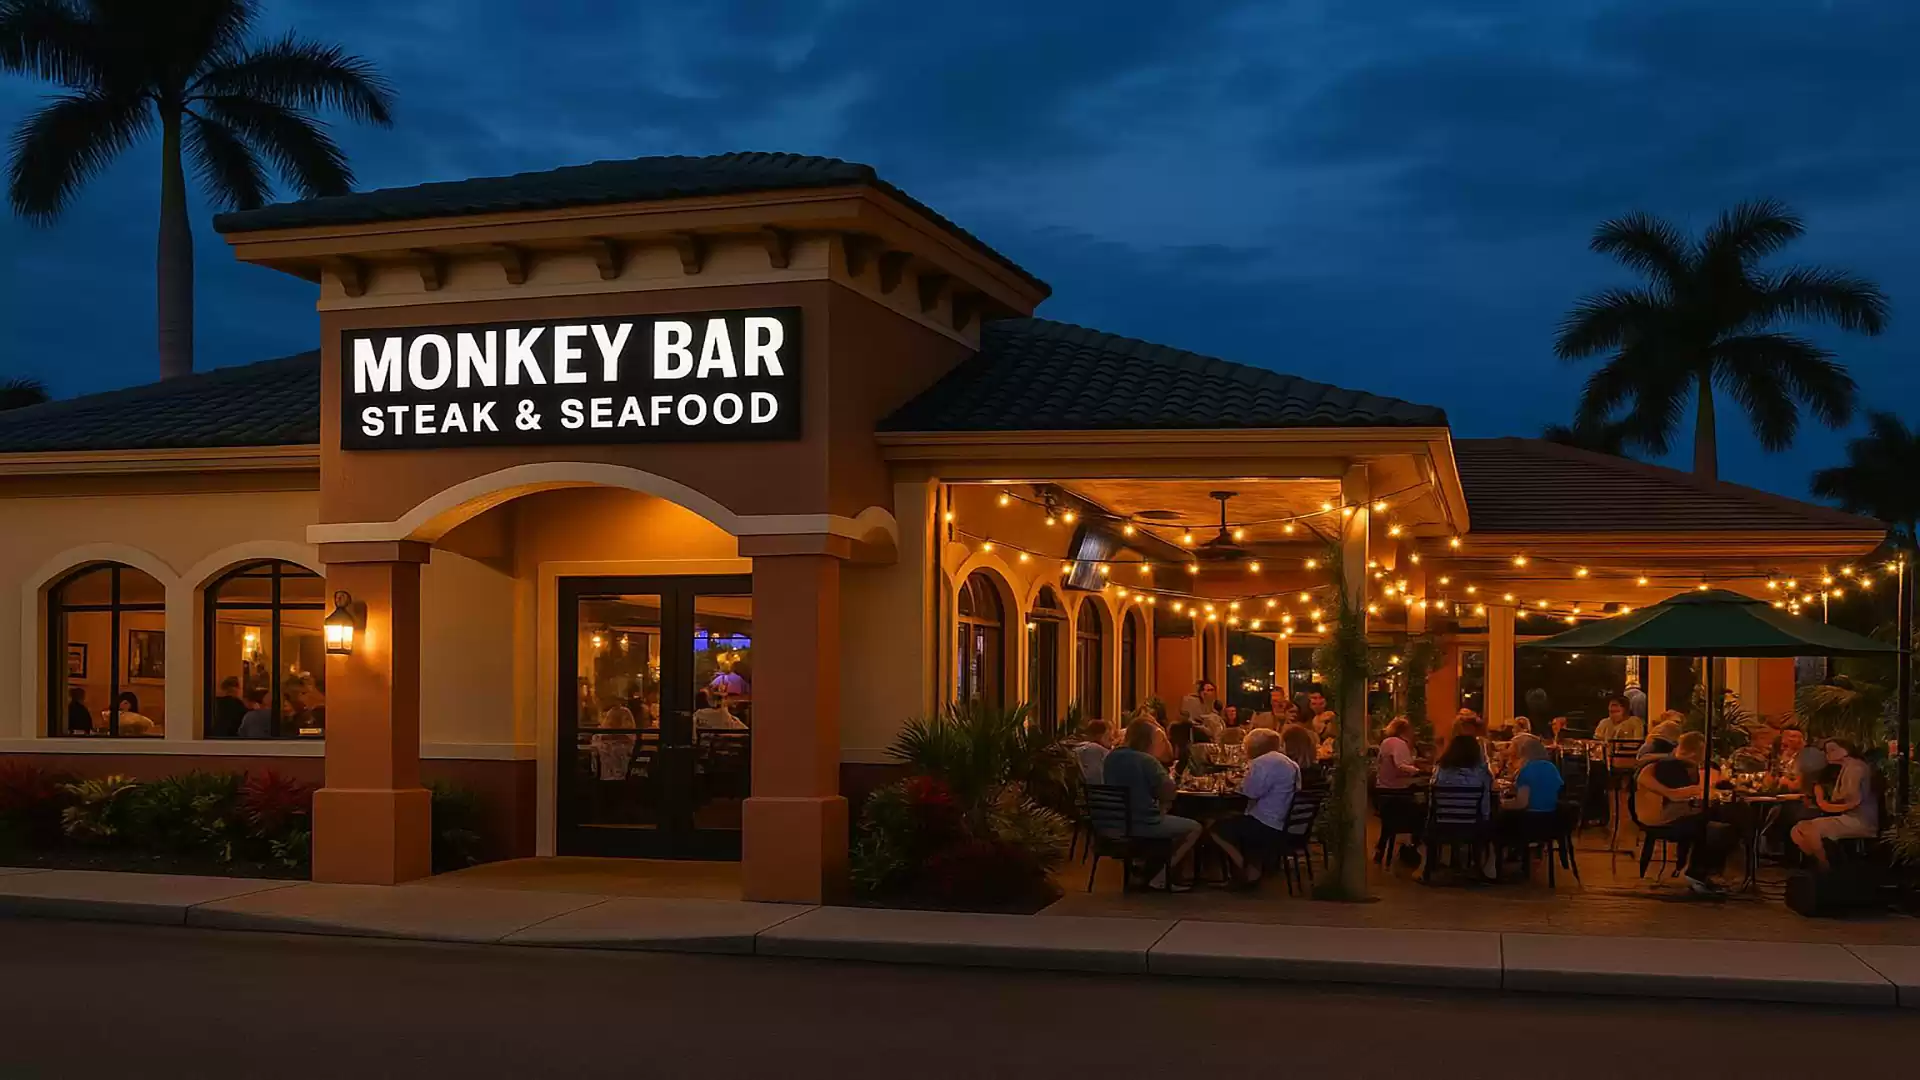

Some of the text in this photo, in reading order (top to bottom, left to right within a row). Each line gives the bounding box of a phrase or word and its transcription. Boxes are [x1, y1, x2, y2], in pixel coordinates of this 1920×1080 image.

[353, 316, 785, 394] MONKEY BAR
[361, 391, 778, 437] STEAK & SEAFOOD
